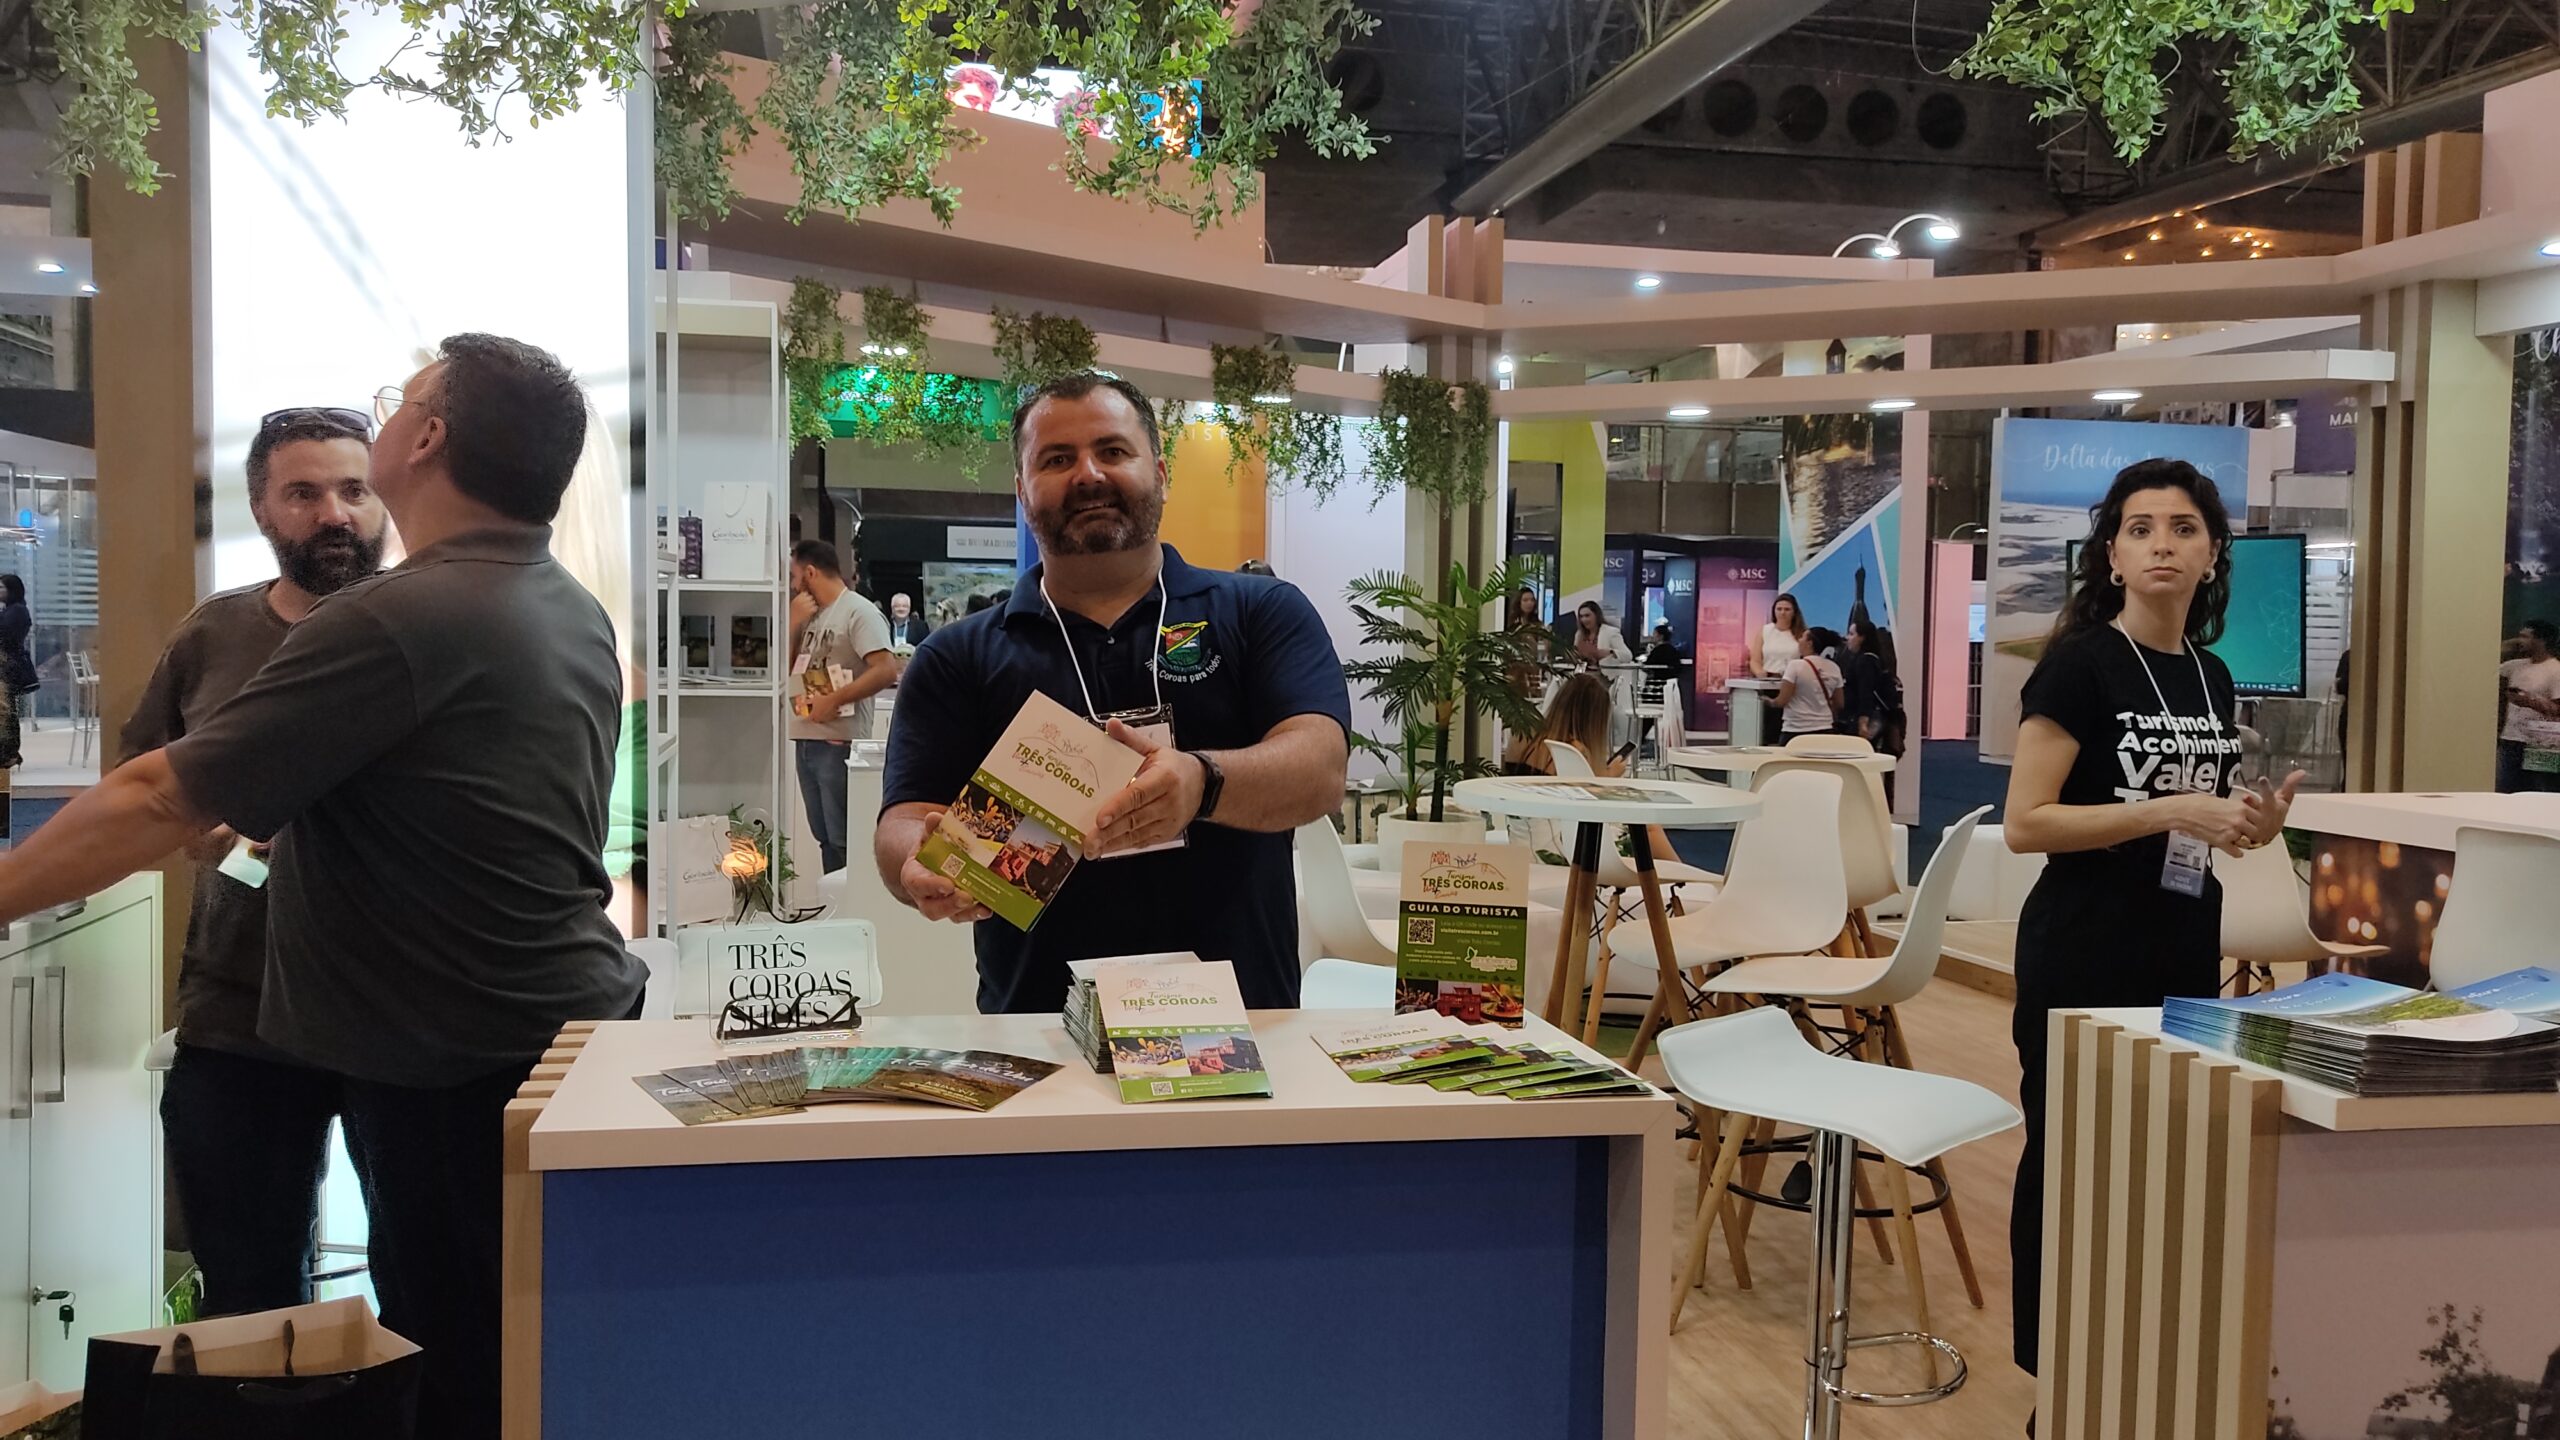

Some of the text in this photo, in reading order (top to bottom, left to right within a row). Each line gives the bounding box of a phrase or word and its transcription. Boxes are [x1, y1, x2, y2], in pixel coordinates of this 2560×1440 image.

[1740, 568, 1767, 580] MSC
[1675, 579, 1692, 592] MSC
[1189, 671, 1208, 684] para
[1015, 742, 1045, 767] TRÊS
[1045, 762, 1095, 798] COROAS
[2117, 751, 2216, 791] Vale
[1422, 876, 1505, 891] TRÊS COROAS
[1408, 904, 1519, 917] GUIA DO TURISTA
[728, 934, 807, 970] TRÊS
[729, 969, 852, 1001] COROAS
[1121, 997, 1218, 1007] TRÊS COROAS
[729, 1000, 829, 1032] SHOES
